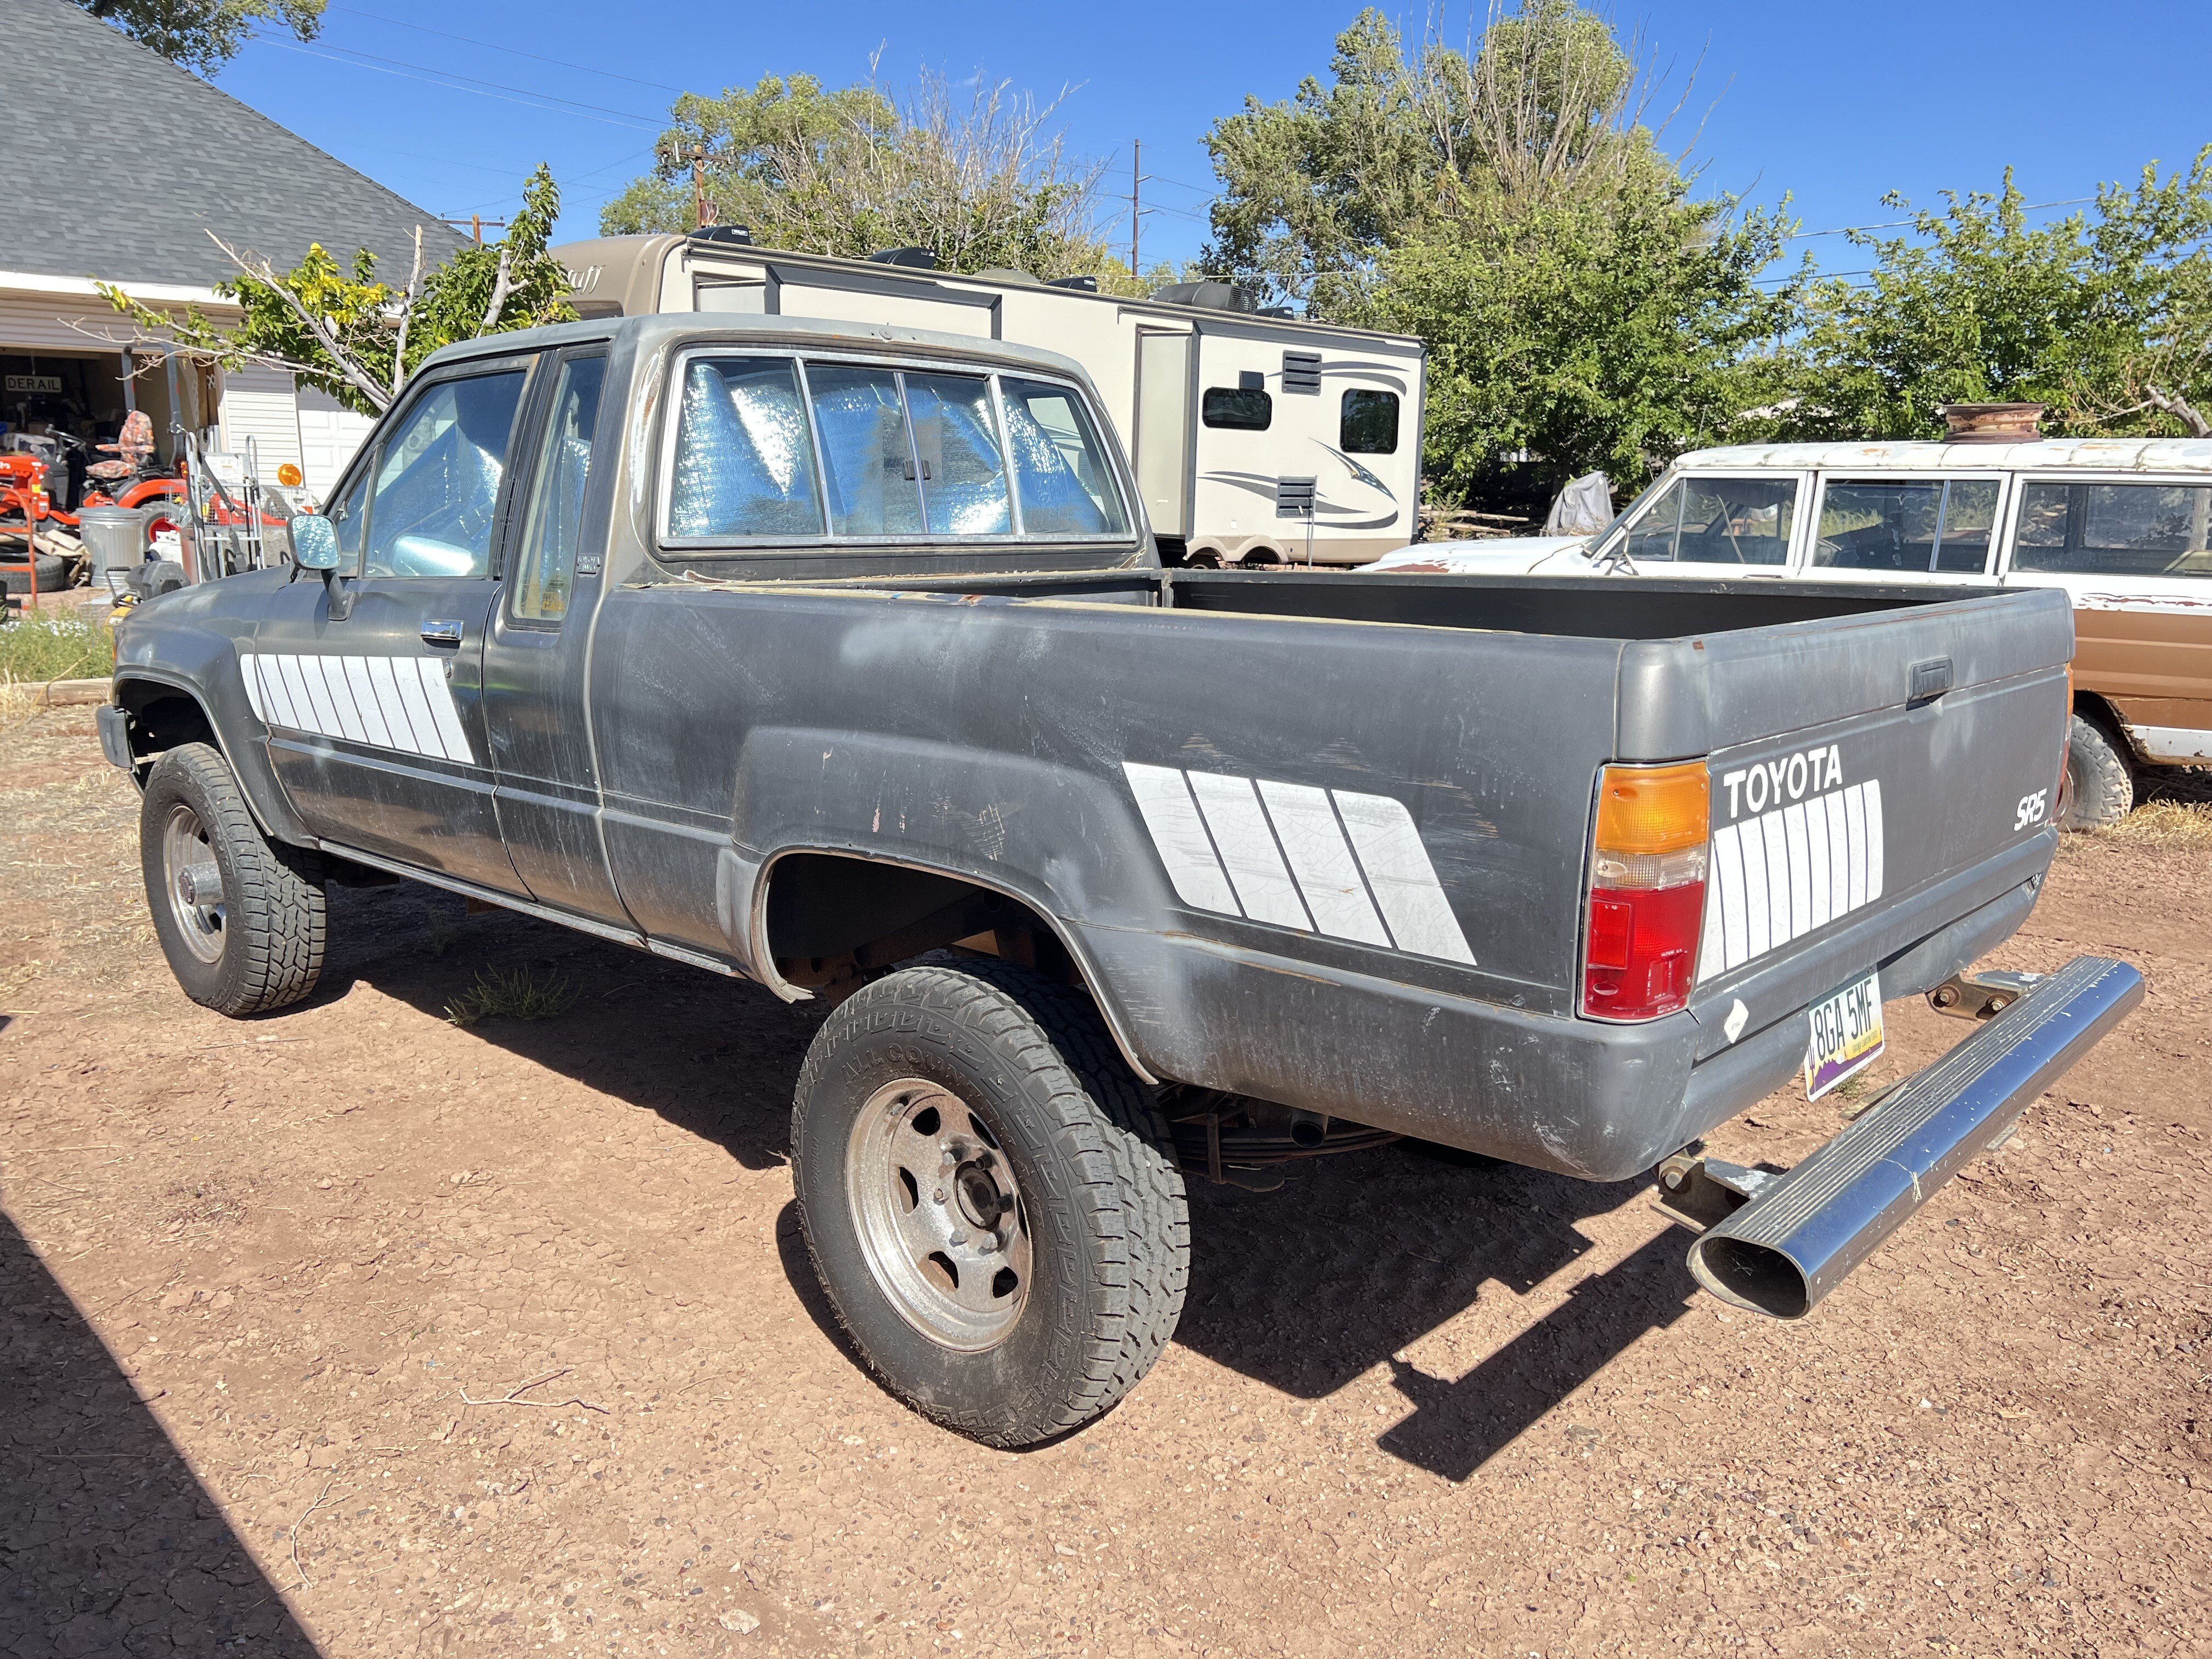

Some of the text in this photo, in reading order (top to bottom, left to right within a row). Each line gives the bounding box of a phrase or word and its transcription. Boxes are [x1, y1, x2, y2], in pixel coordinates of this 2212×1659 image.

[7, 377, 60, 390] DERAIL
[1723, 744, 1842, 819] TOYOTA
[2013, 788, 2047, 831] SR5
[1814, 978, 1872, 1062] 8GA 5MF
[842, 1047, 884, 1086] ALL
